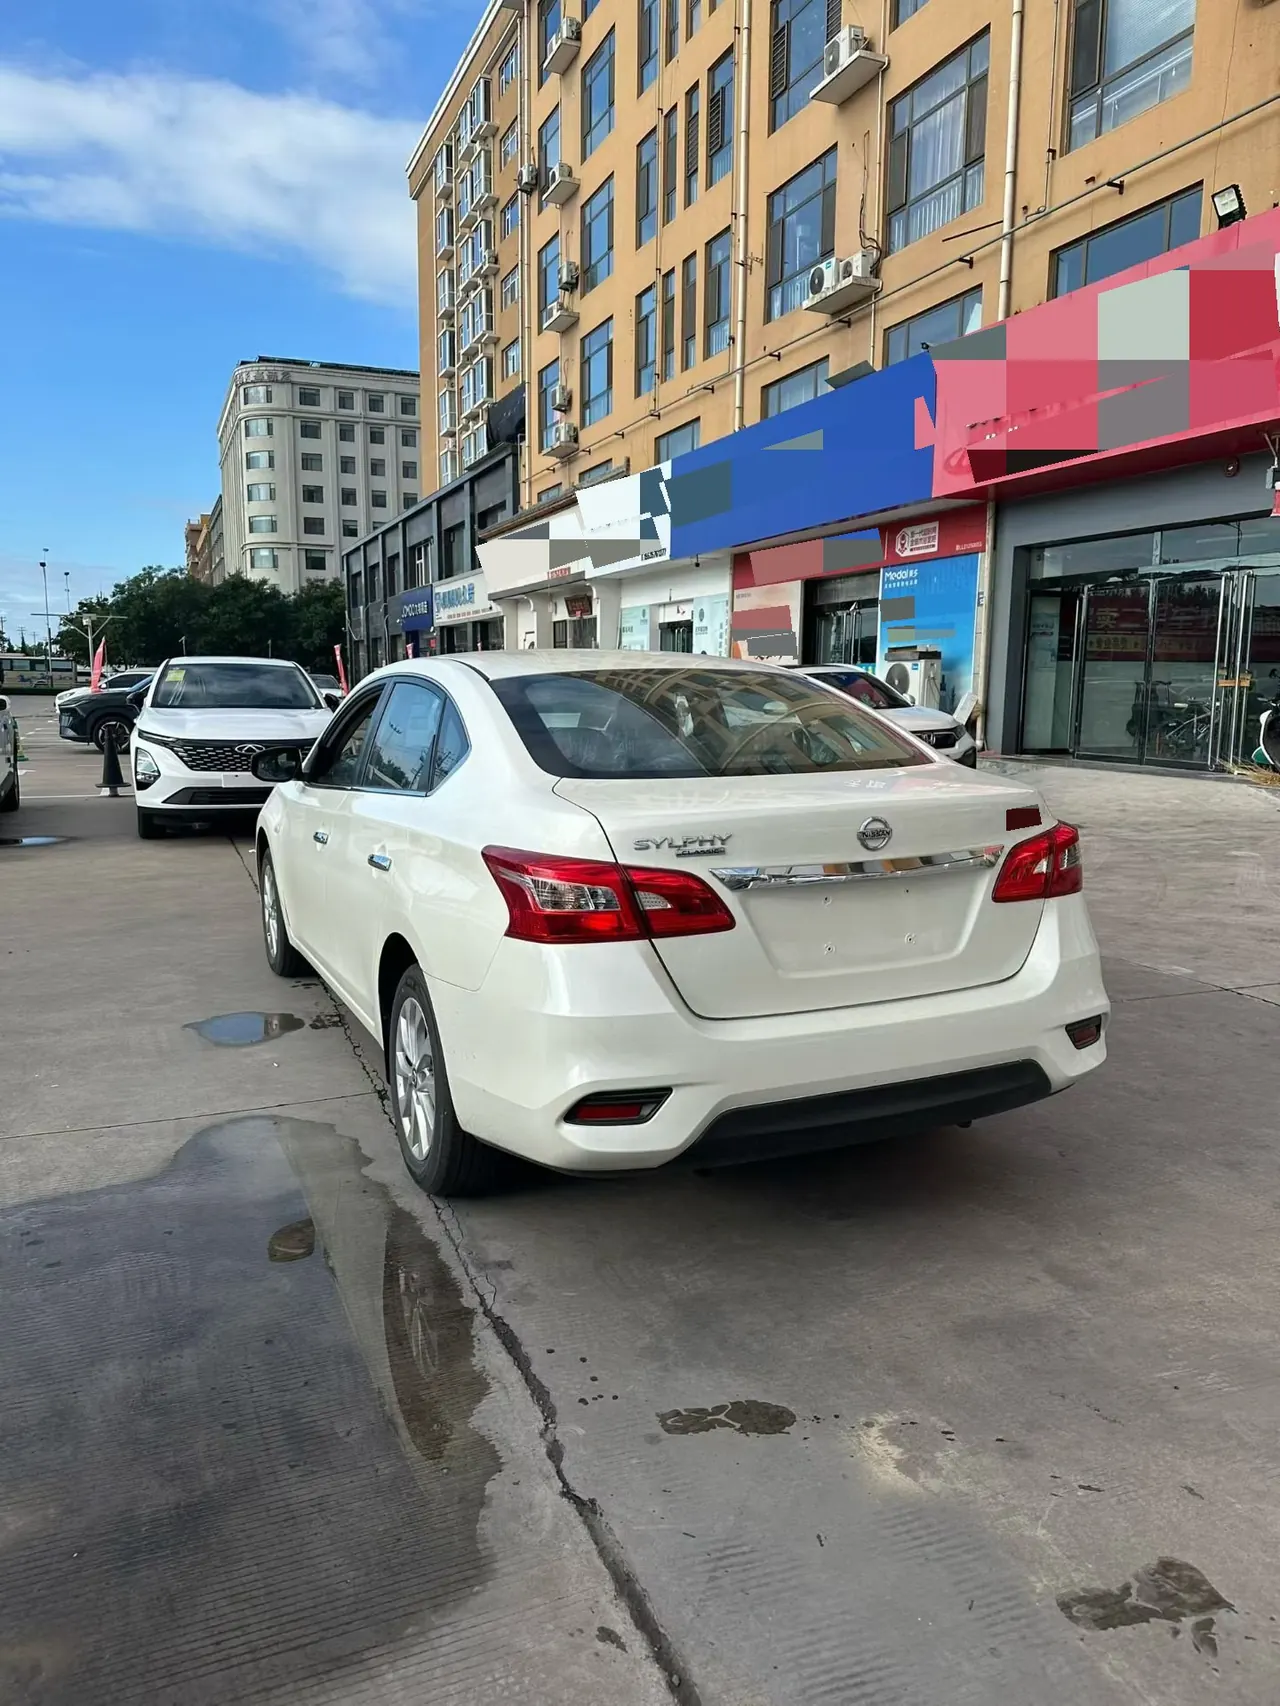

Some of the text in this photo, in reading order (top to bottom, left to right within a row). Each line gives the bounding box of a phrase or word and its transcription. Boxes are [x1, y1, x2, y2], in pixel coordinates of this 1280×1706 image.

[862, 829, 891, 838] NISSAN
[632, 832, 733, 851] SYLPHY
[681, 848, 720, 856] CLASSIC
